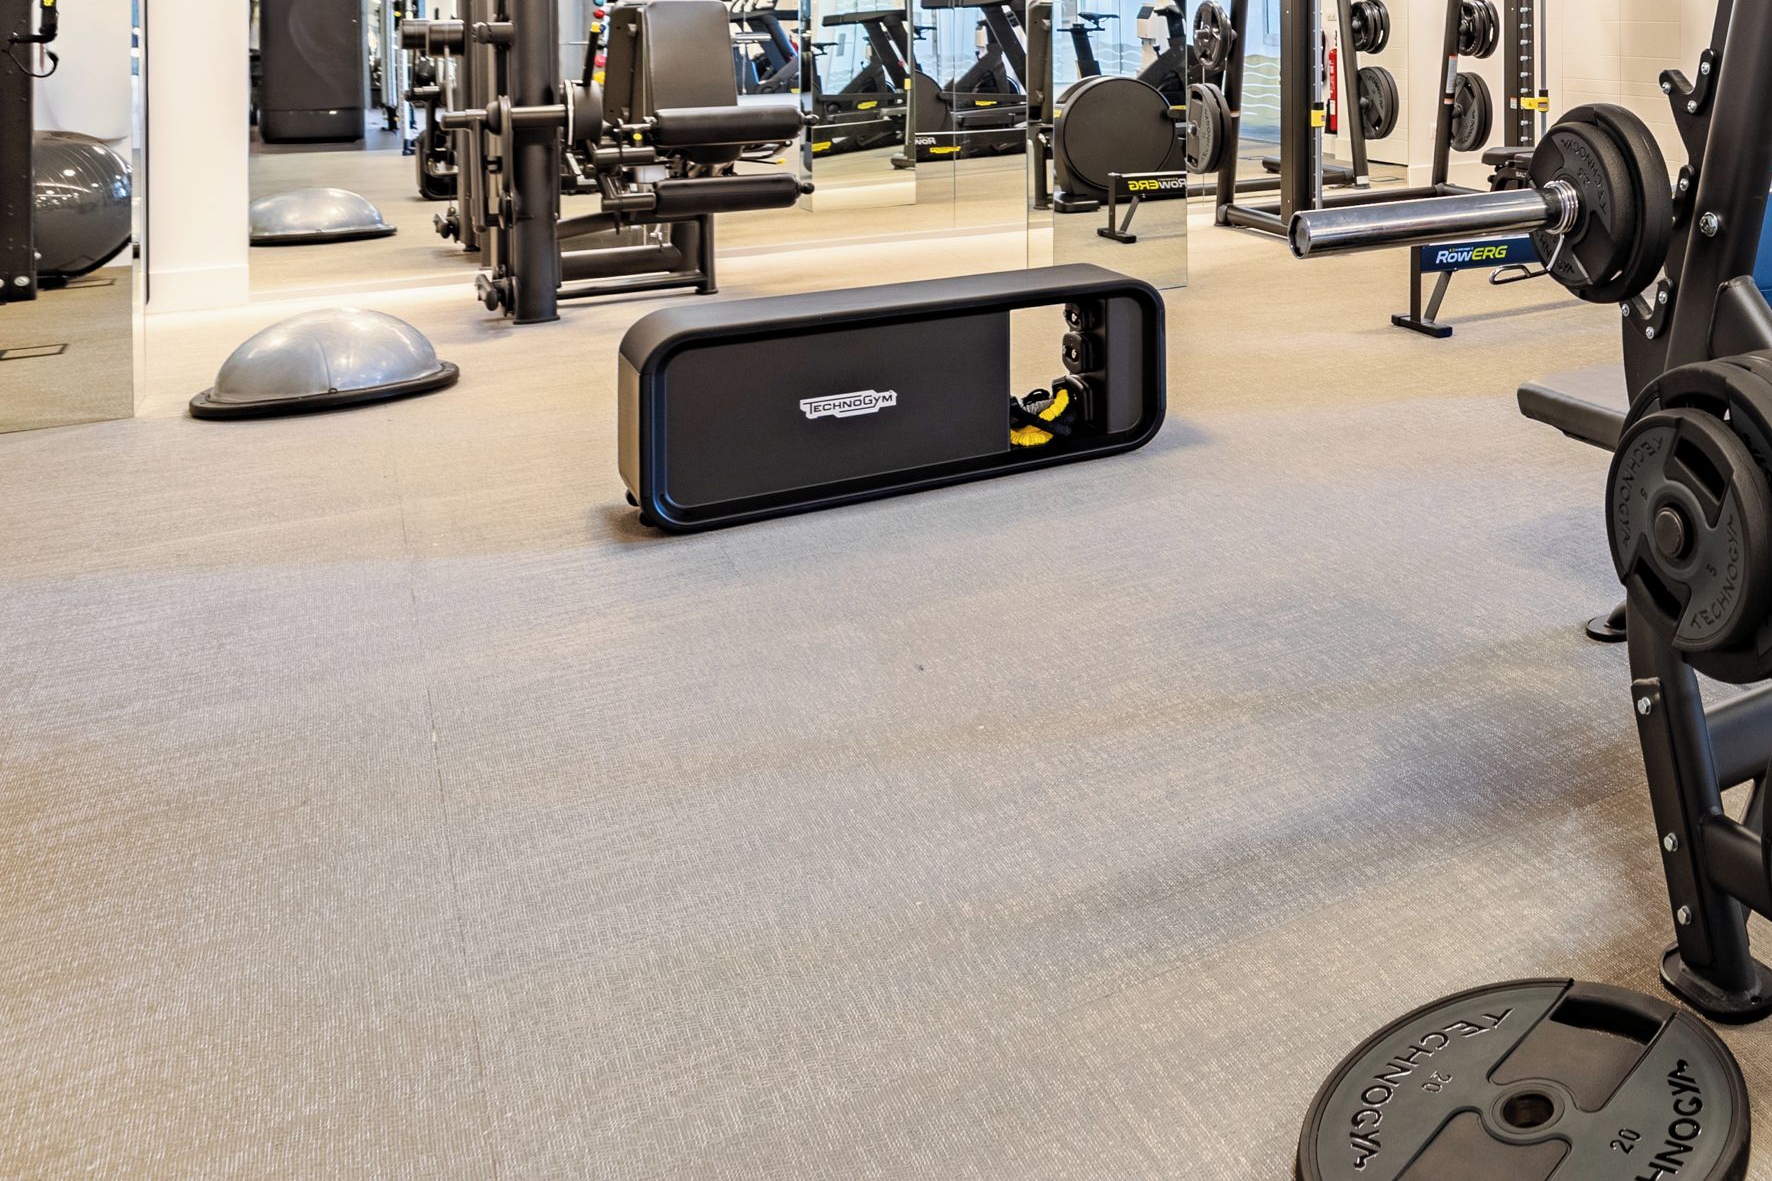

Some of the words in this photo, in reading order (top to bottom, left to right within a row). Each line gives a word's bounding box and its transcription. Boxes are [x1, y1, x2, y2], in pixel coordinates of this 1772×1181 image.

[1435, 245, 1508, 264] RowERG
[802, 395, 894, 414] TECHNOGYM
[1349, 1007, 1515, 1172] TECHNOGYM
[1420, 1070, 1453, 1094] 20
[1609, 1128, 1642, 1156] 20
